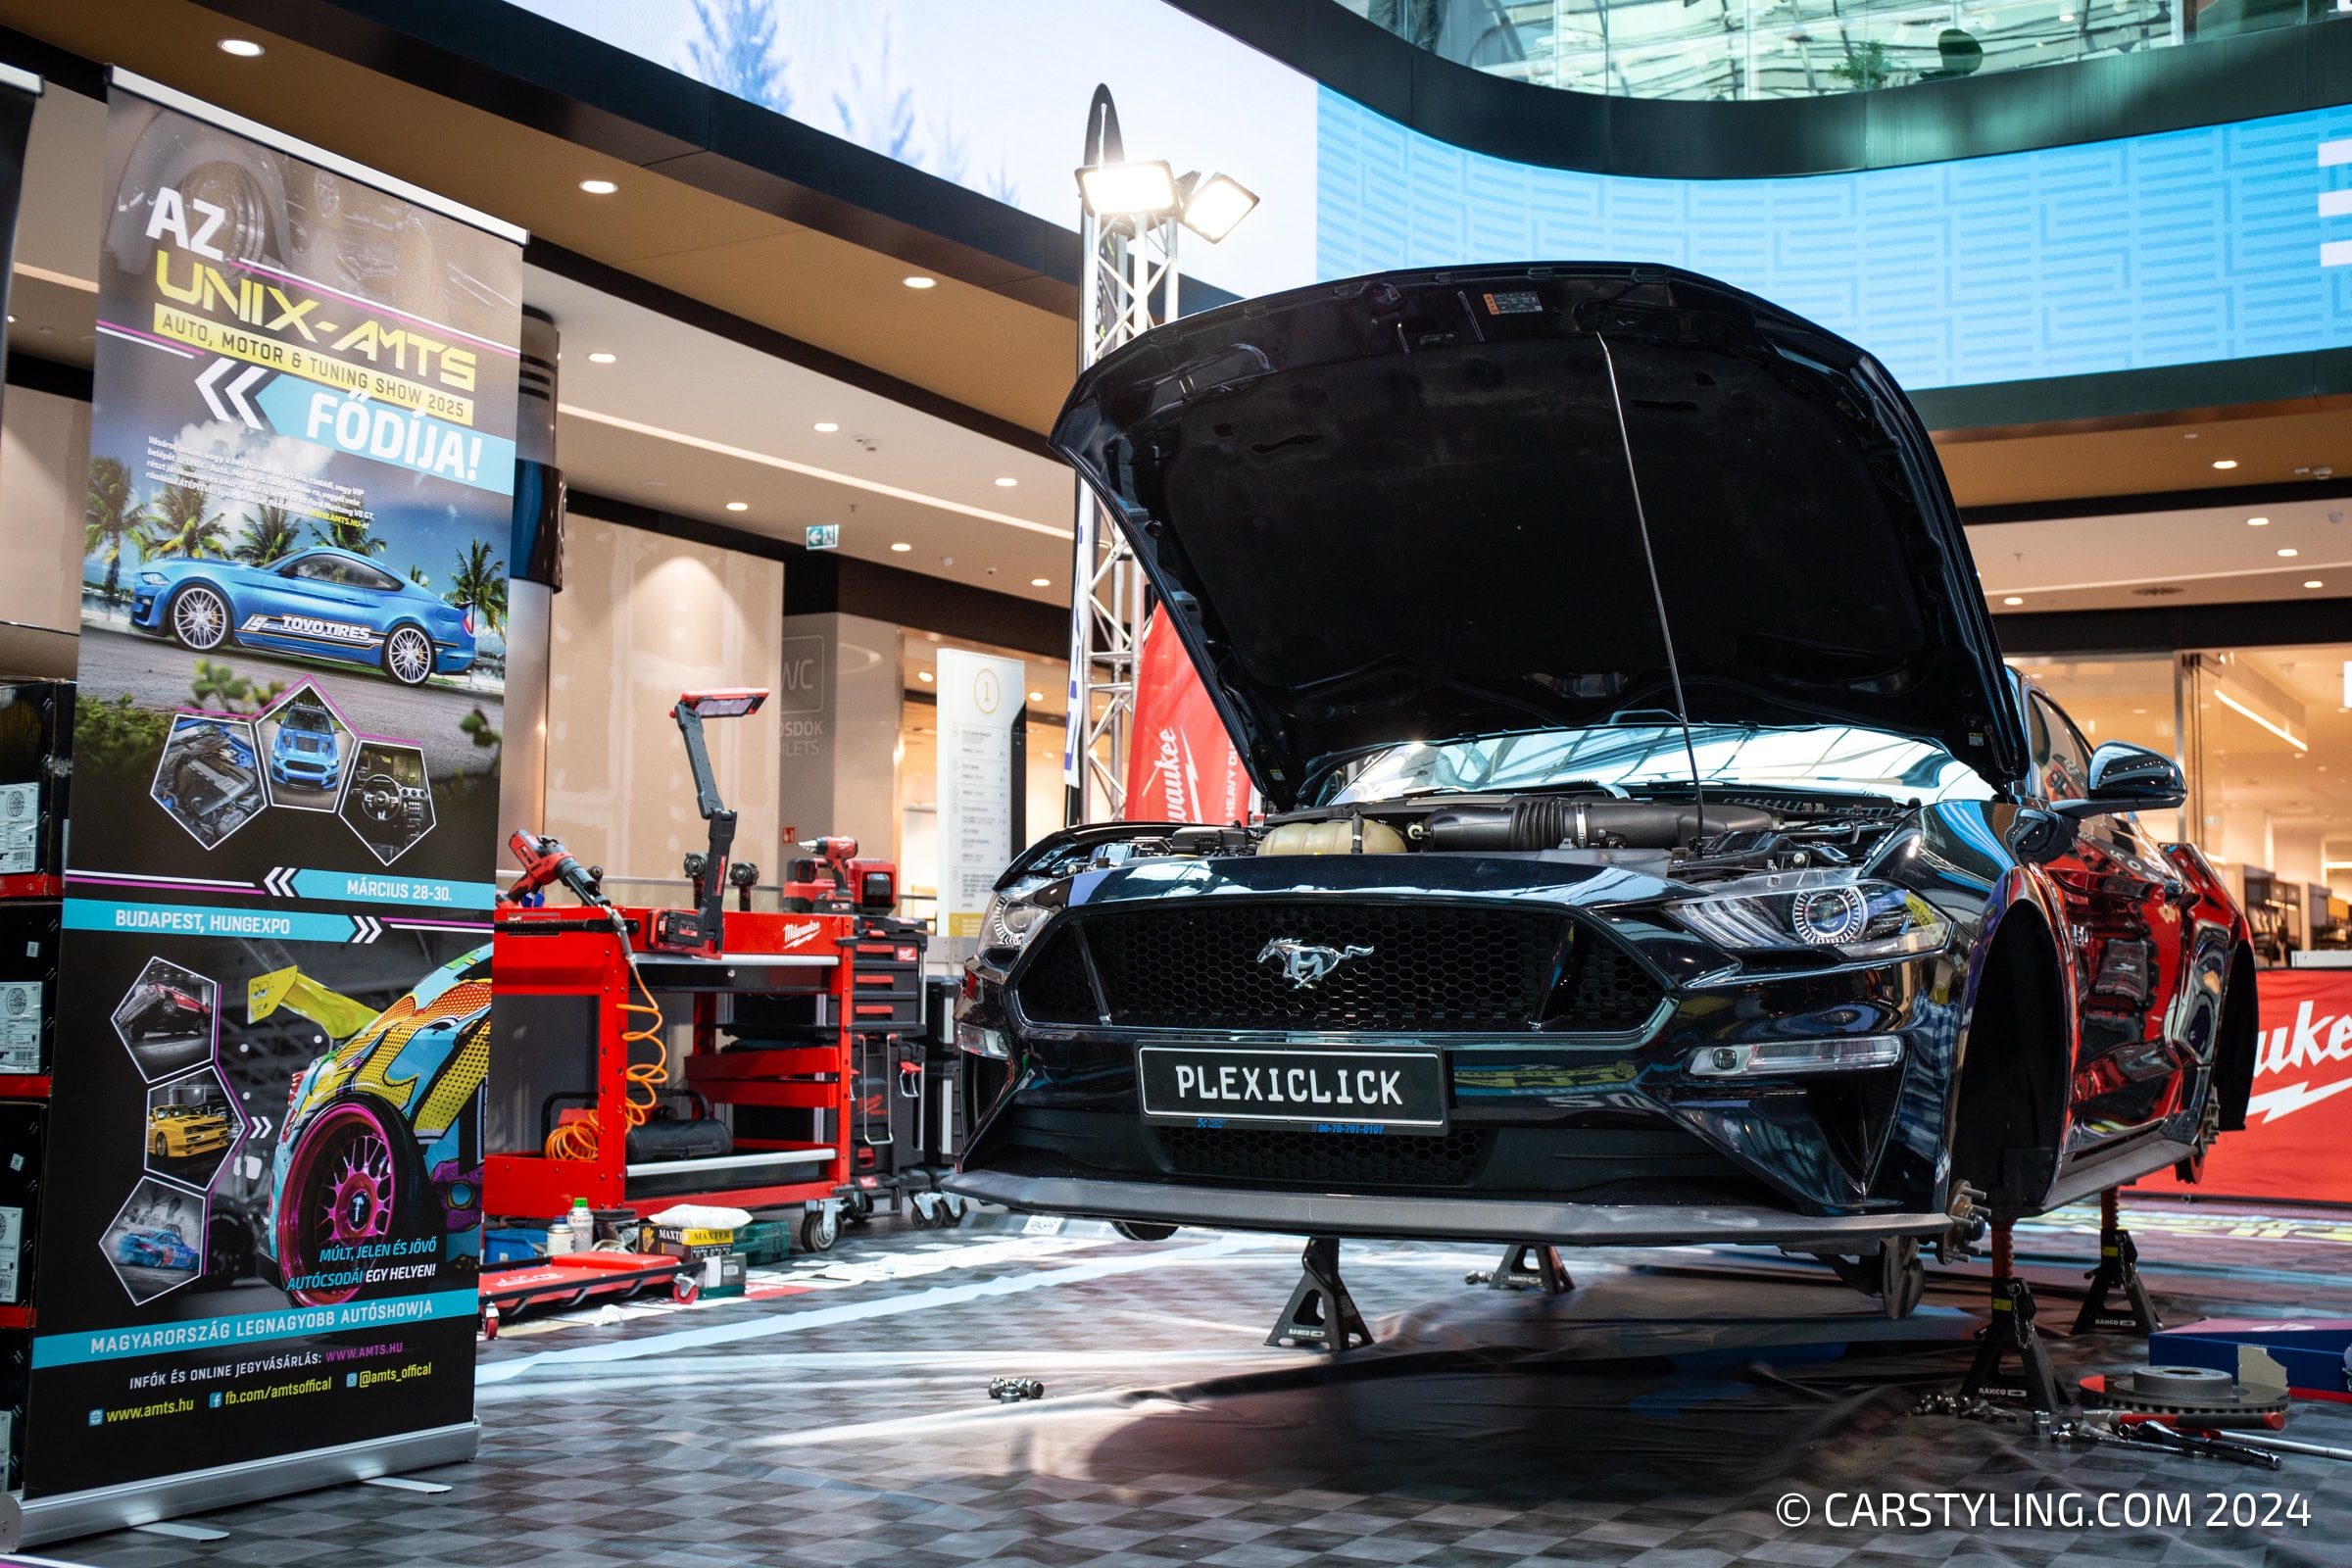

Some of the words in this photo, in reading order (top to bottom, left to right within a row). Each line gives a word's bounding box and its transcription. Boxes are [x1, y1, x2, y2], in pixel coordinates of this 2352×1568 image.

[146, 185, 226, 263] AZ
[156, 249, 477, 392] UNIX-AMTS
[162, 313, 213, 347] AUTO,
[221, 331, 283, 364] MOTOR
[291, 352, 303, 368] &
[310, 356, 368, 389] TUNING
[375, 377, 422, 404] SHOW
[428, 393, 465, 417] 2025
[306, 385, 483, 482] FŐDÍJA!
[149, 435, 177, 451] Vásárolj
[178, 445, 204, 458] online,
[205, 452, 224, 465] vagy
[231, 458, 272, 476] helyszínen
[334, 484, 352, 495] vagy
[352, 487, 366, 496] VIP
[186, 458, 205, 468] UNIX
[210, 464, 230, 475] Autó,
[231, 468, 255, 481] Motor
[267, 477, 291, 491] Tuning
[291, 483, 321, 497] Show-ra,
[322, 491, 345, 504] vegyél
[345, 497, 361, 506] vele
[146, 460, 166, 469] részt
[219, 476, 236, 487] akár
[245, 483, 261, 493] Tiéd
[270, 489, 289, 499] lehet
[308, 498, 324, 508] Ford
[323, 502, 354, 516] Mustang
[364, 511, 375, 520] GT,
[146, 470, 178, 485] ráadásul
[268, 500, 303, 514] Részletek
[281, 614, 325, 635] TOYO
[322, 621, 371, 641] TIRES
[984, 680, 991, 703] 1
[1225, 769, 1237, 818] HEAVY
[347, 876, 409, 900] MÁRCIUS
[413, 884, 453, 902] 28-30.
[116, 908, 205, 934] BUDAPEST,
[210, 914, 291, 935] HUNGEXPO
[782, 920, 820, 943] Milwaukee
[1175, 1064, 1403, 1105] PLEXICLICK
[1318, 1124, 1385, 1135] 06-70-701-0107
[318, 1245, 355, 1263] MÚLT,
[356, 1243, 391, 1260] JELEN
[392, 1239, 408, 1255] ÉS
[409, 1236, 437, 1255] JÖVŐ
[659, 1228, 689, 1243] MAXTER
[694, 1230, 731, 1241] MAXTER
[286, 1267, 365, 1292] AUTÓCSODÁI
[365, 1268, 389, 1283] EGY
[389, 1263, 437, 1281] HELYEN!
[90, 1320, 230, 1354] MAGYARORSZÁG
[236, 1310, 335, 1337] LEGNAGYOBB
[340, 1298, 433, 1324] AUTÓSHOWJA
[1288, 1328, 1310, 1337] BAHCO
[128, 1371, 167, 1390] INFÓK
[170, 1368, 185, 1385] ÉS
[190, 1364, 232, 1382] ONLINE
[234, 1350, 322, 1377] JEGYVÁSÁRLÁS:
[325, 1342, 404, 1363] WWW.AMTS.HU
[106, 1396, 195, 1423] www.amts.hu
[224, 1376, 332, 1405] fb.com/amtsoffical
[359, 1361, 432, 1389] @amts_offical
[1979, 1387, 2006, 1396] BAHCO
